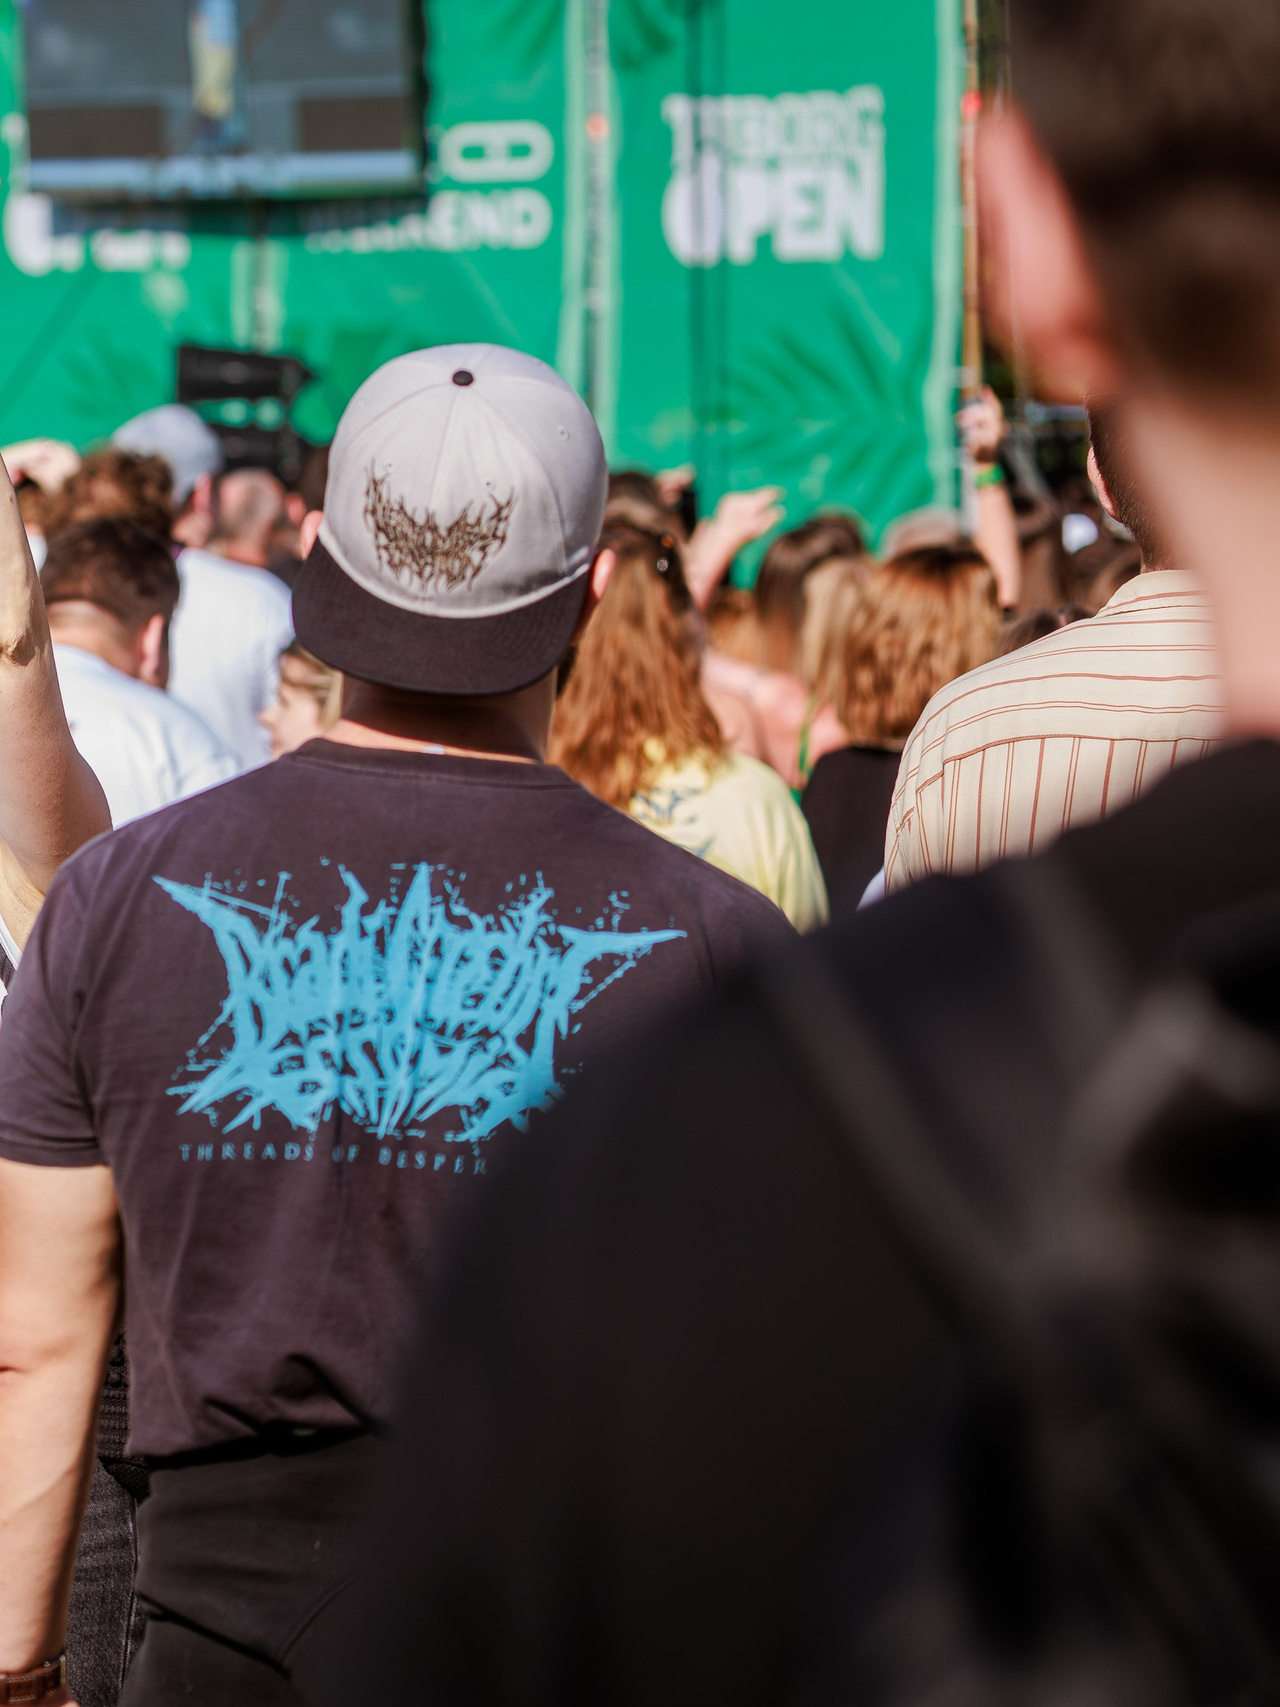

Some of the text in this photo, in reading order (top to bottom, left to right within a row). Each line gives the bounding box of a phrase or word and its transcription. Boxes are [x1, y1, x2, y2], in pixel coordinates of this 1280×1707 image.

[660, 155, 887, 269] OPEN
[179, 1142, 315, 1162] THREADS
[332, 1144, 361, 1163] OF
